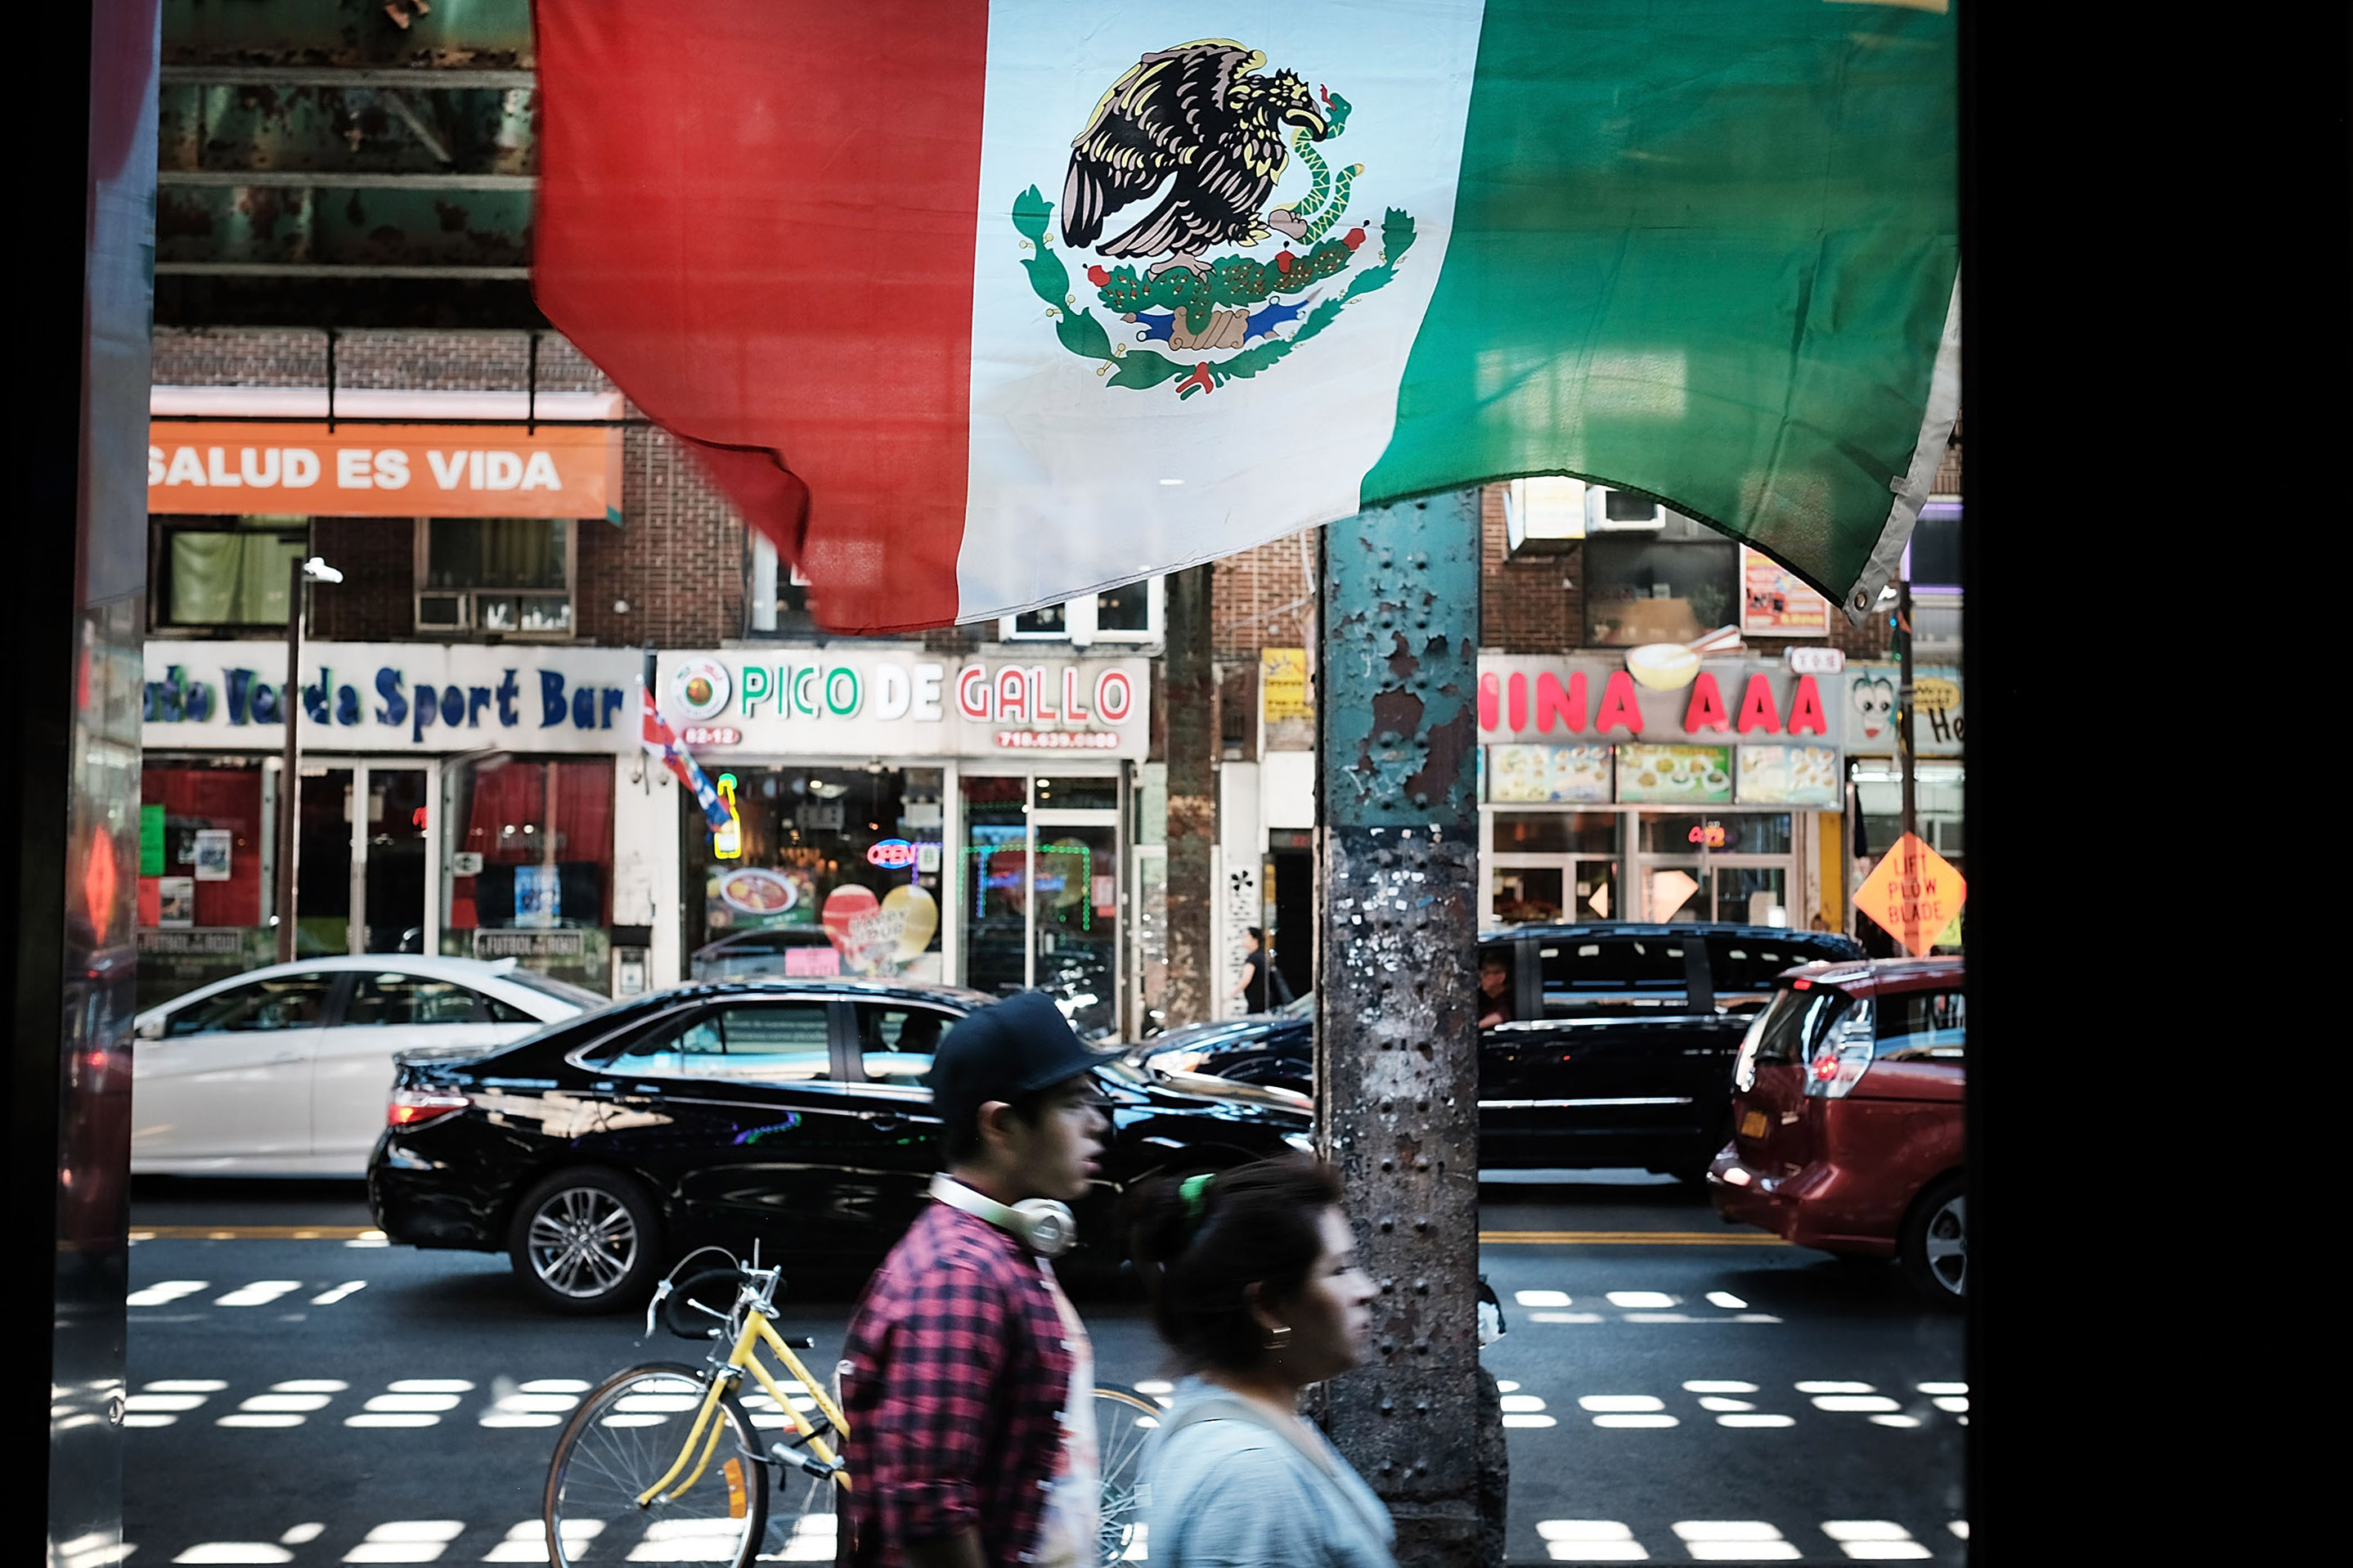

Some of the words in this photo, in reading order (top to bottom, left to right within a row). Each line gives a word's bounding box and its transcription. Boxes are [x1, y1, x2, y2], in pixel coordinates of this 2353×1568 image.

[337, 448, 411, 490] ES
[426, 450, 562, 491] VIDA
[375, 667, 519, 743] Sport
[537, 667, 625, 730] Bar
[739, 663, 863, 720] PICO
[874, 663, 943, 721] DE
[955, 663, 1135, 726] GALLO
[1685, 672, 1827, 735] AAA
[867, 843, 918, 865] OPEN
[1893, 853, 1927, 877] LIFT
[1888, 878, 1937, 899] PLOW
[1888, 901, 1944, 924] BLADE
